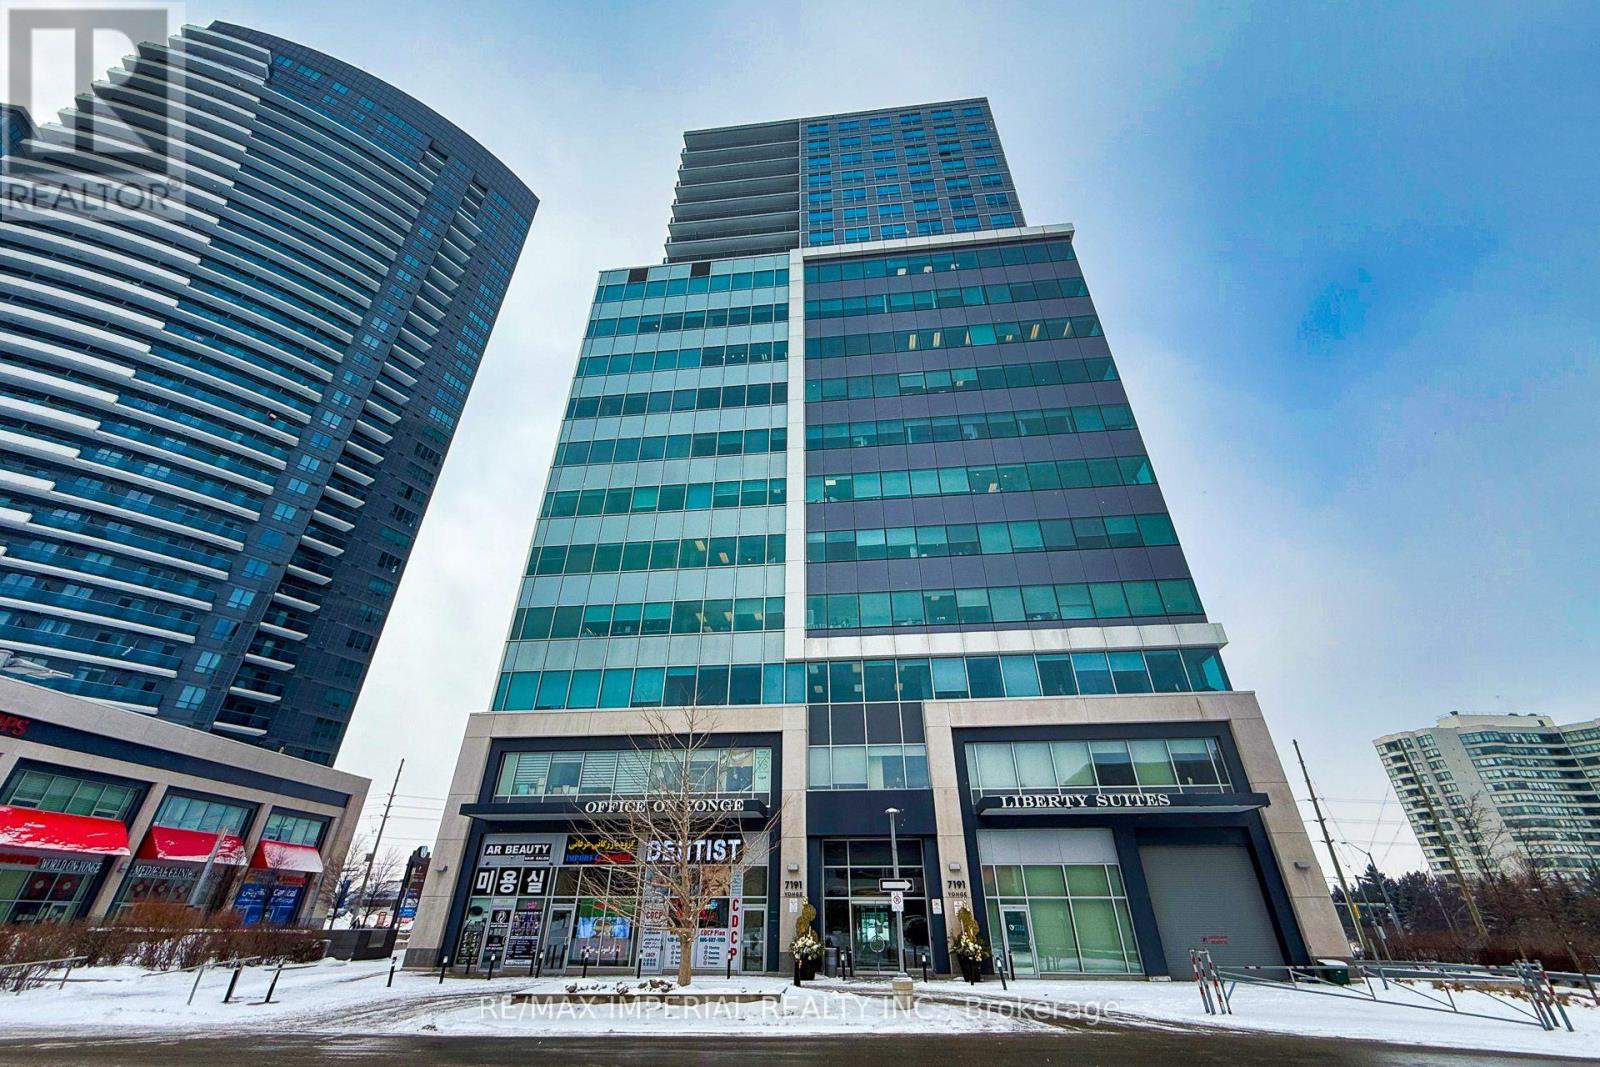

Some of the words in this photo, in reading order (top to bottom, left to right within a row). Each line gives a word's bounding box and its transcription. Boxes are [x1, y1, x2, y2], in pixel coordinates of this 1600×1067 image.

[585, 801, 646, 813] OFFICE
[686, 799, 744, 811] YONGE
[1001, 795, 1088, 808] LIBERTY
[1096, 794, 1171, 807] SUITES
[486, 845, 502, 854] AR
[505, 844, 549, 854] BEAUTY
[646, 839, 741, 861] DENTIST
[40, 858, 68, 872] WORLD
[134, 865, 168, 877] MEDICAL
[476, 870, 545, 893] 미용실
[785, 881, 803, 889] 7191
[947, 880, 966, 889] 7191
